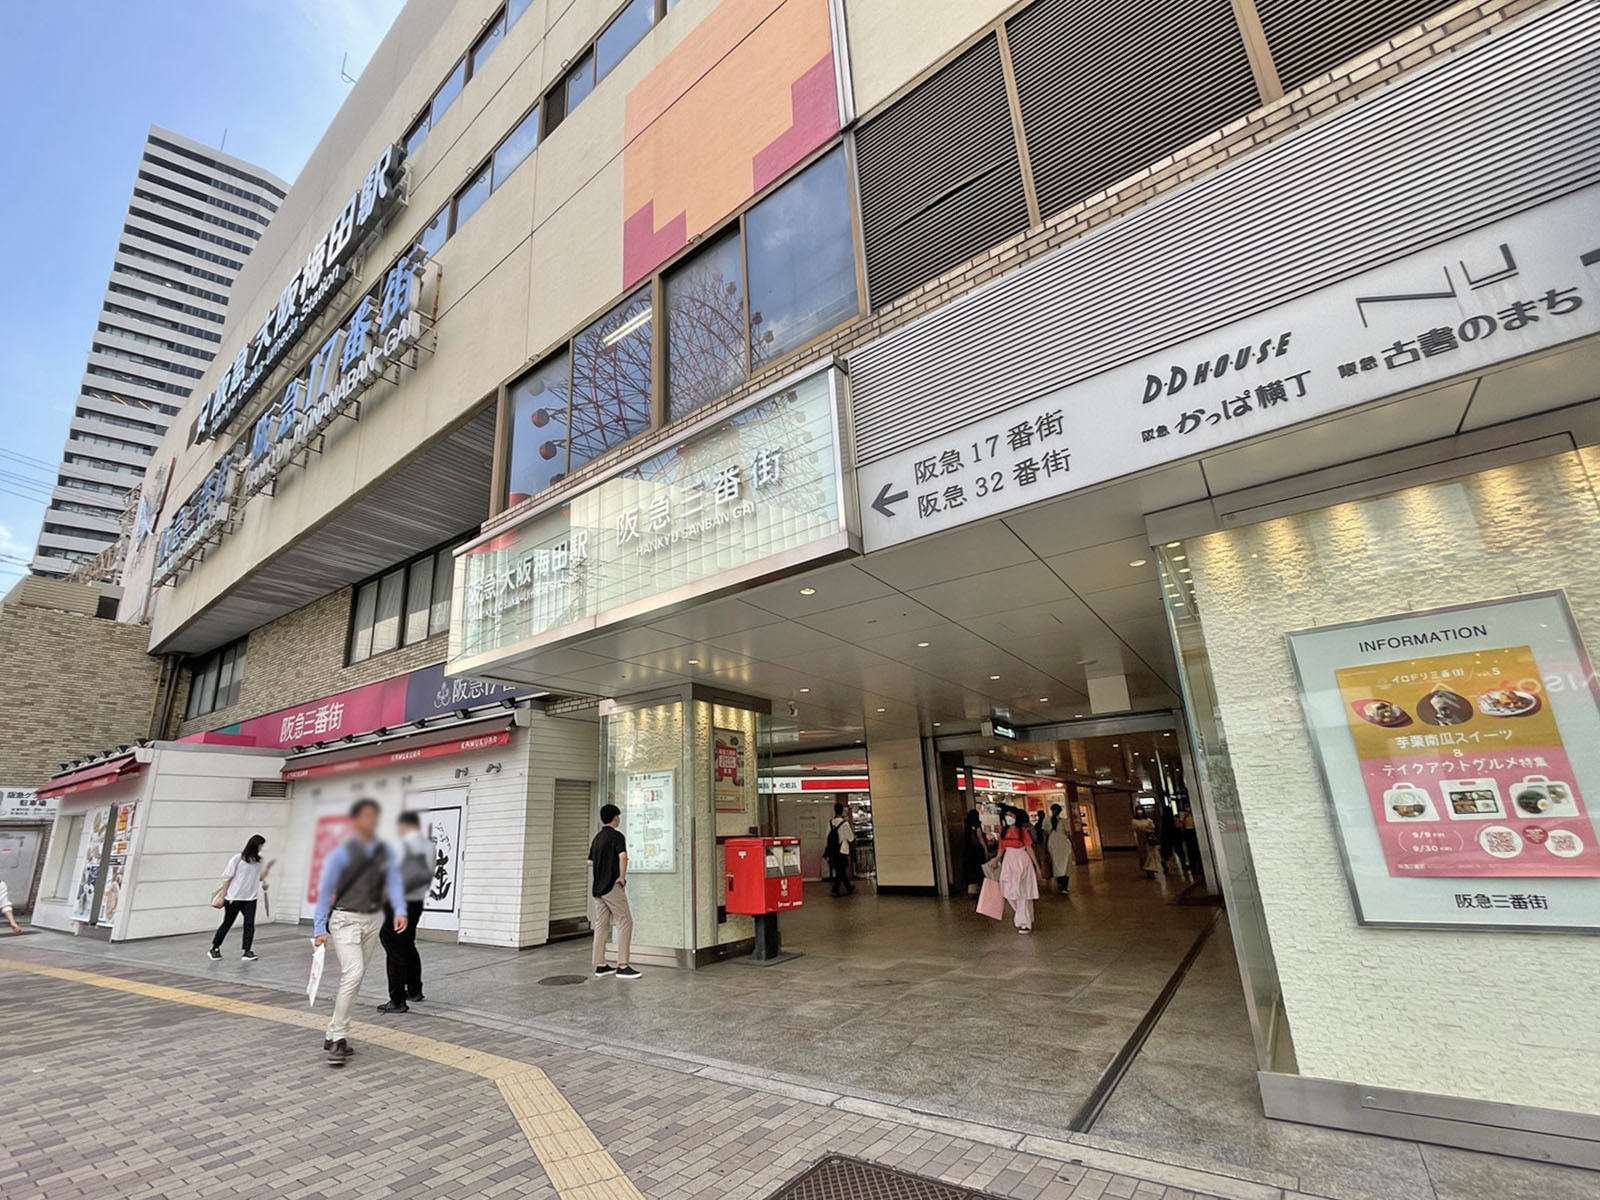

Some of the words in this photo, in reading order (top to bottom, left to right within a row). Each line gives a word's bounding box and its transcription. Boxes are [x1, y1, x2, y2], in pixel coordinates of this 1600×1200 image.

[300, 267, 340, 322] Station
[1337, 355, 1379, 378] 阪急
[1381, 287, 1583, 369] 古書のまち
[1141, 425, 1170, 443] 阪急
[1174, 370, 1312, 435] かっぱ横丁
[616, 446, 784, 547] 阪急三番街
[636, 530, 679, 556] HANKYU
[682, 511, 730, 539] SANBAN
[732, 501, 755, 519] GAI
[1359, 624, 1488, 652] INFORMATION
[452, 679, 516, 703] 阪急17
[280, 702, 344, 743] 阪急三番街
[1382, 757, 1551, 777] テイクアウトグルメ特集
[1455, 893, 1548, 910] 阪急三番街
